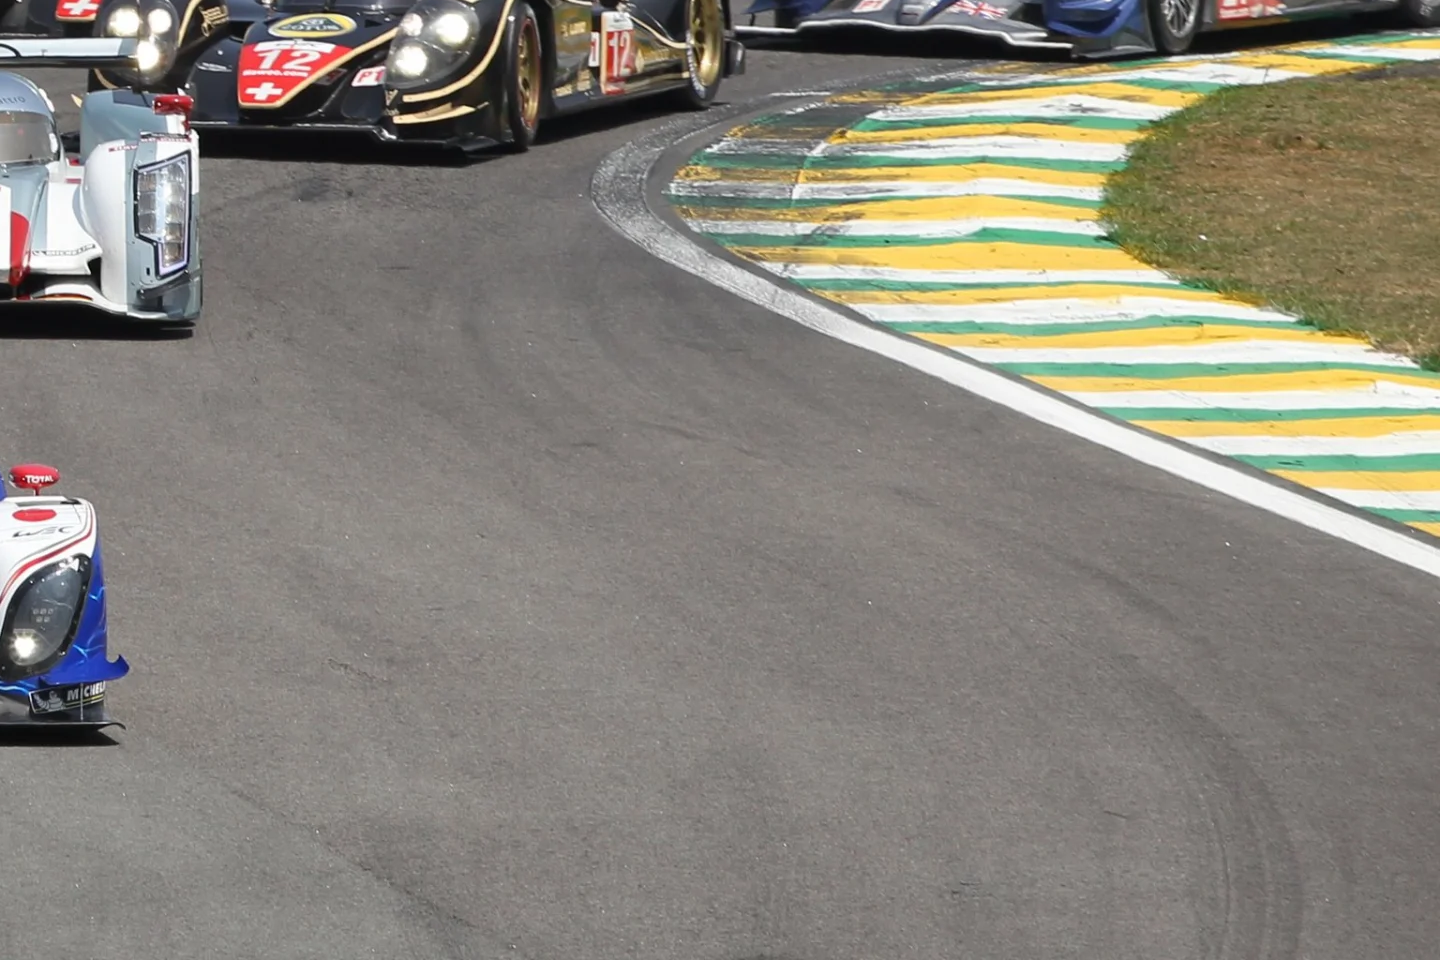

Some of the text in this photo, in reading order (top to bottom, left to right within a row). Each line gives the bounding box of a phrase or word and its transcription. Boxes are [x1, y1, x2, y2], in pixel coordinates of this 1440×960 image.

[257, 50, 321, 71] 12
[608, 31, 631, 77] 12
[359, 70, 385, 84] P1
[25, 474, 54, 484] TOTAL
